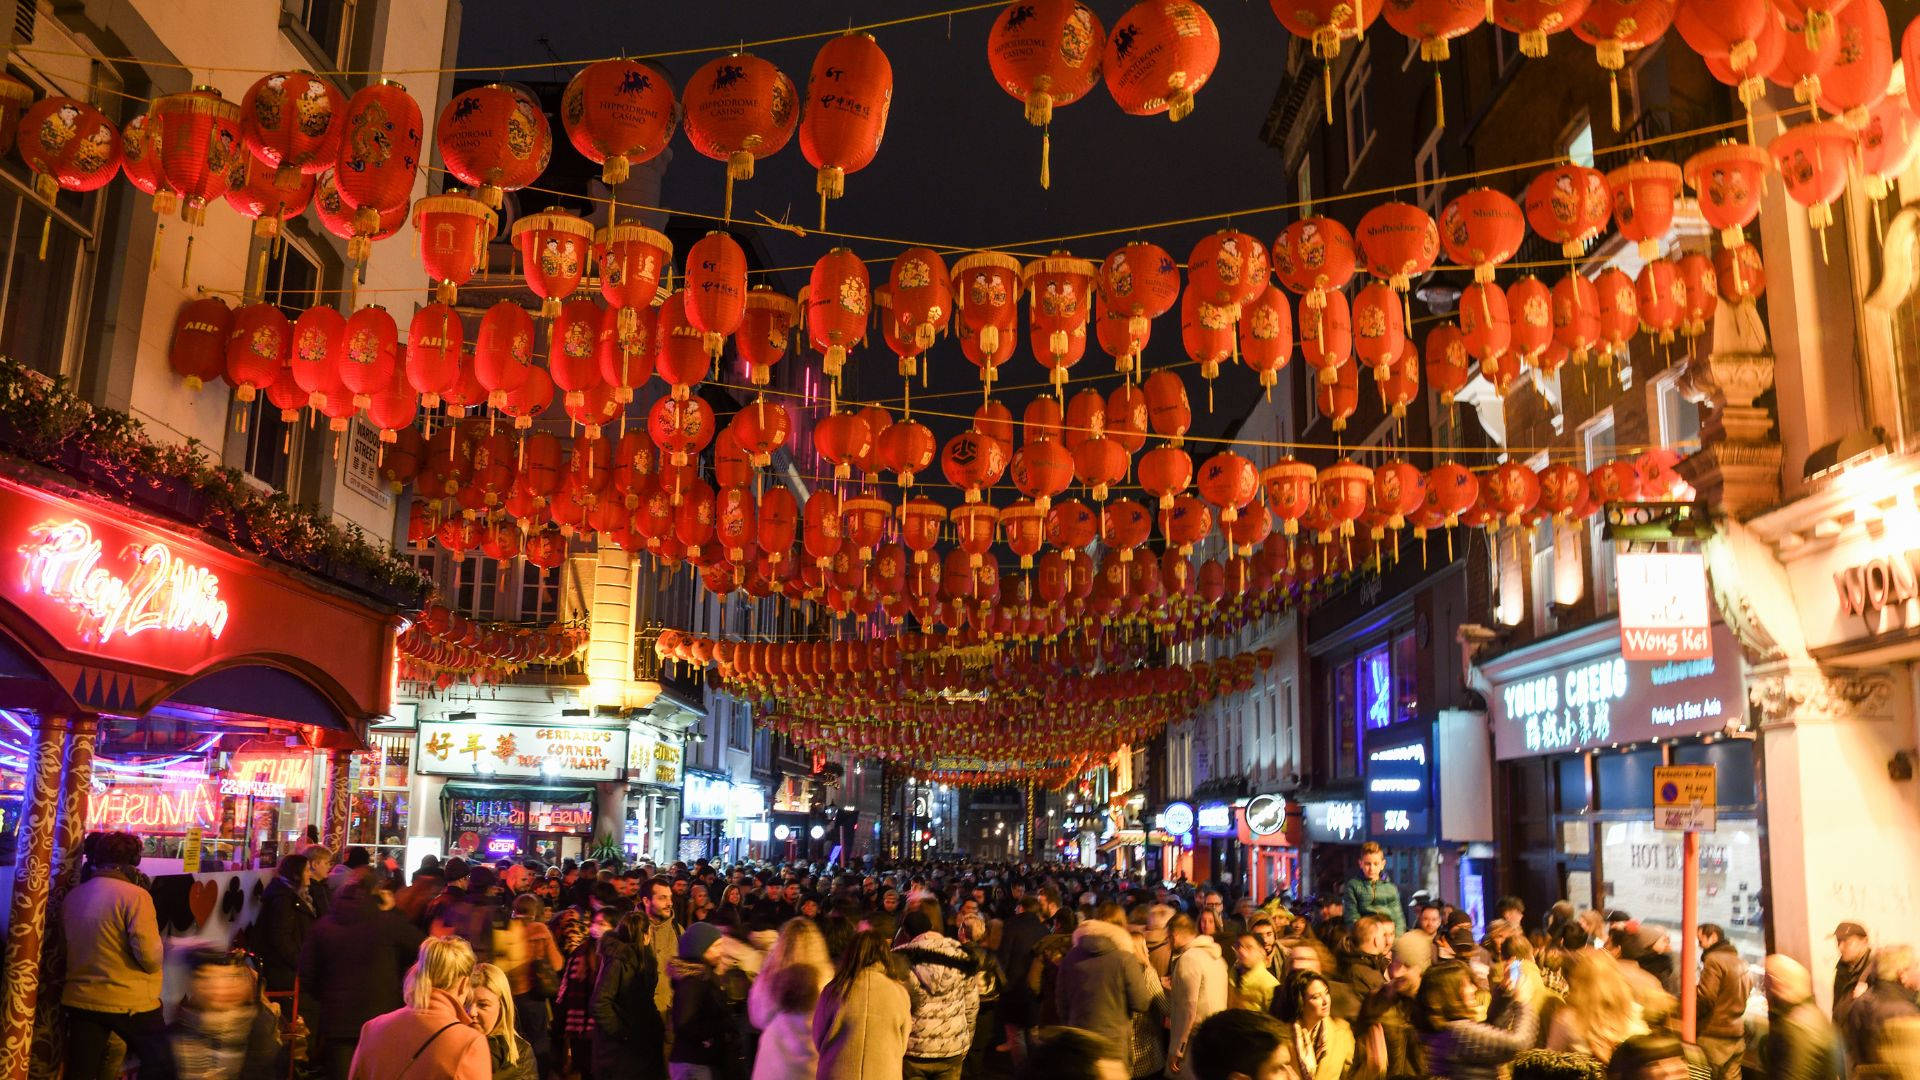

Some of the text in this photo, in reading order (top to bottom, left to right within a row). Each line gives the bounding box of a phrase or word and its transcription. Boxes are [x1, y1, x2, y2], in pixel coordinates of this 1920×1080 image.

[354, 439, 376, 462] STREET
[30, 519, 132, 643] Play
[123, 542, 171, 637] 2
[1625, 627, 1708, 656] Wong Kei
[1503, 656, 1629, 720] YOUNG CHENG
[425, 731, 518, 765] 好年華
[536, 729, 612, 743] GERRARD'S
[547, 743, 602, 757] CORNER
[463, 813, 486, 825] DIM
[488, 841, 515, 852] OPEN
[1631, 844, 1659, 869] HOT
